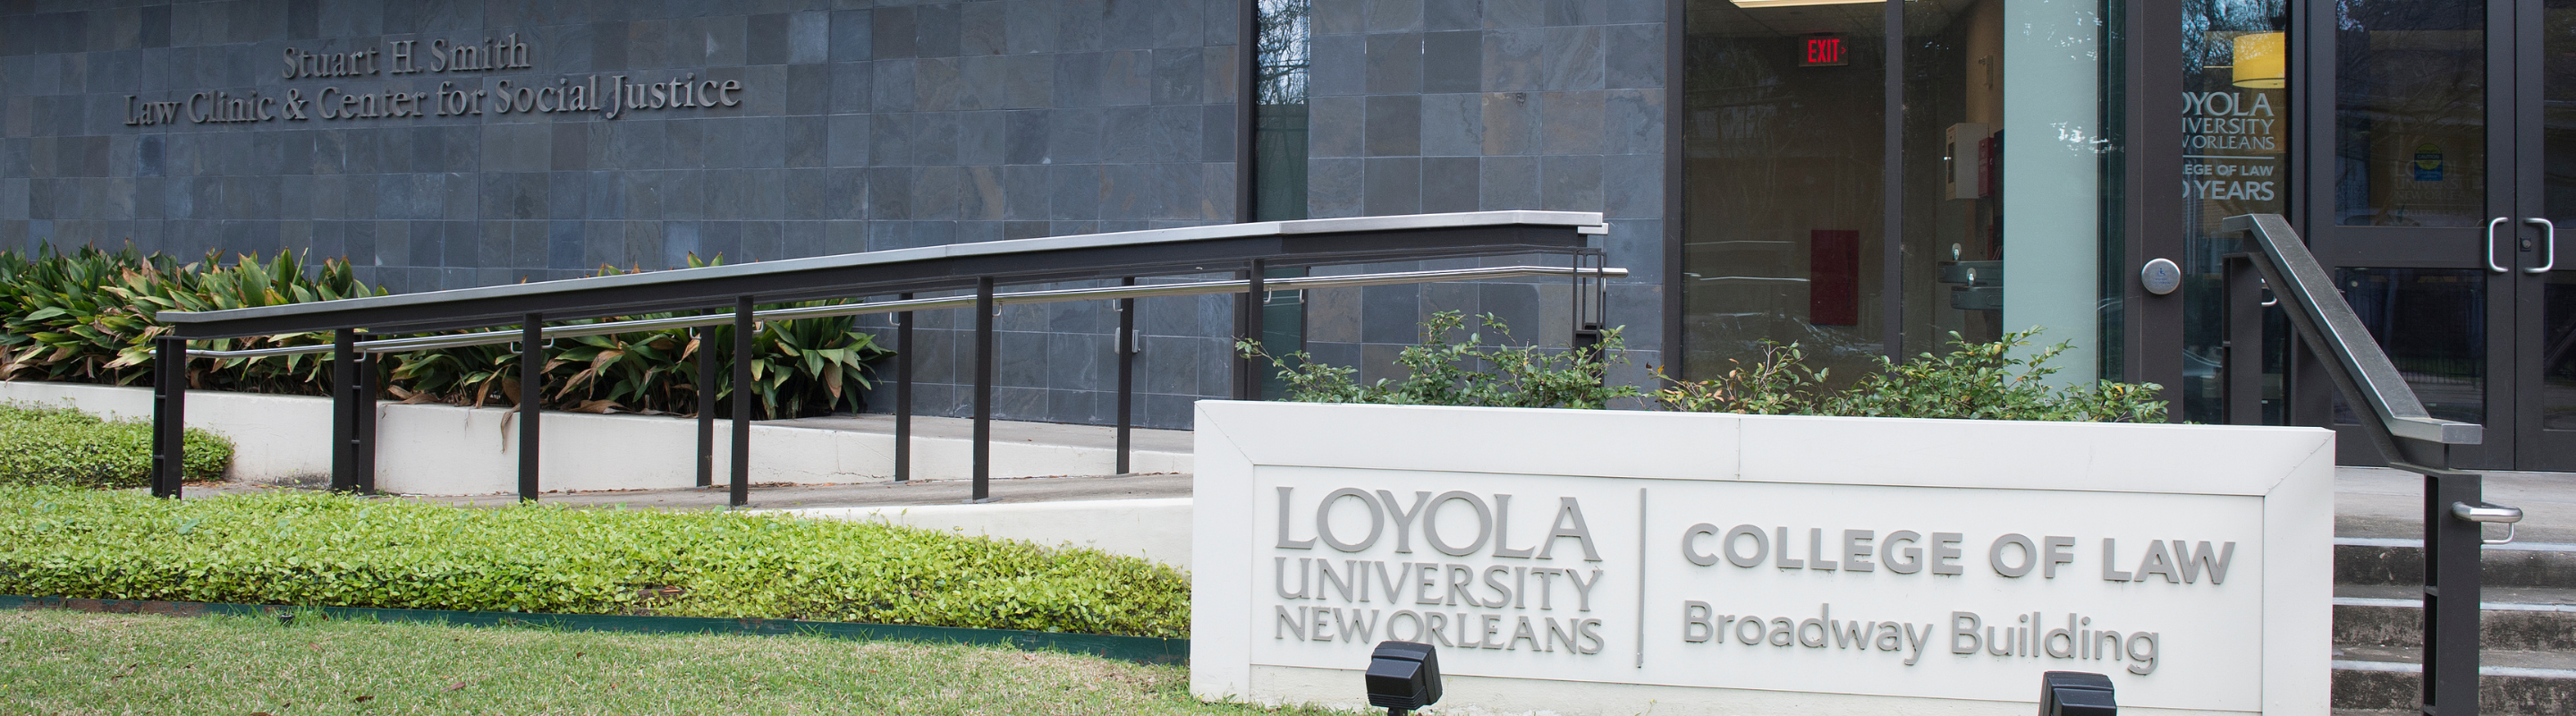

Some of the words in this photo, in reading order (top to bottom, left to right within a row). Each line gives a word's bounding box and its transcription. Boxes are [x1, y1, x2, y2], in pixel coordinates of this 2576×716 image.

[282, 46, 379, 79] Stuart
[389, 40, 423, 74] H.
[430, 33, 532, 73] Smith
[1808, 38, 1840, 63] EXIT
[123, 93, 180, 125] Law
[186, 89, 275, 124] Clinic
[282, 88, 309, 121] &
[316, 86, 428, 119] Center
[436, 81, 487, 116] for
[495, 73, 601, 115] Social
[606, 71, 742, 119] Justice
[2192, 135, 2275, 149] ORLEANS
[2182, 164, 2213, 175] EGE
[2217, 165, 2237, 175] OF
[2241, 165, 2274, 176] LAW
[2193, 180, 2275, 201] YEARS
[1275, 486, 1603, 562] LOYOLA
[1682, 522, 1964, 575] COLLEGE
[1989, 533, 2077, 579] OF
[2103, 537, 2236, 584] LAW
[1275, 556, 1604, 611] UNIVERSITY
[1275, 604, 1380, 644] NEW
[1386, 609, 1605, 655] ORLEANS
[1683, 600, 1934, 665] Broadway
[1952, 610, 2160, 676] Building
